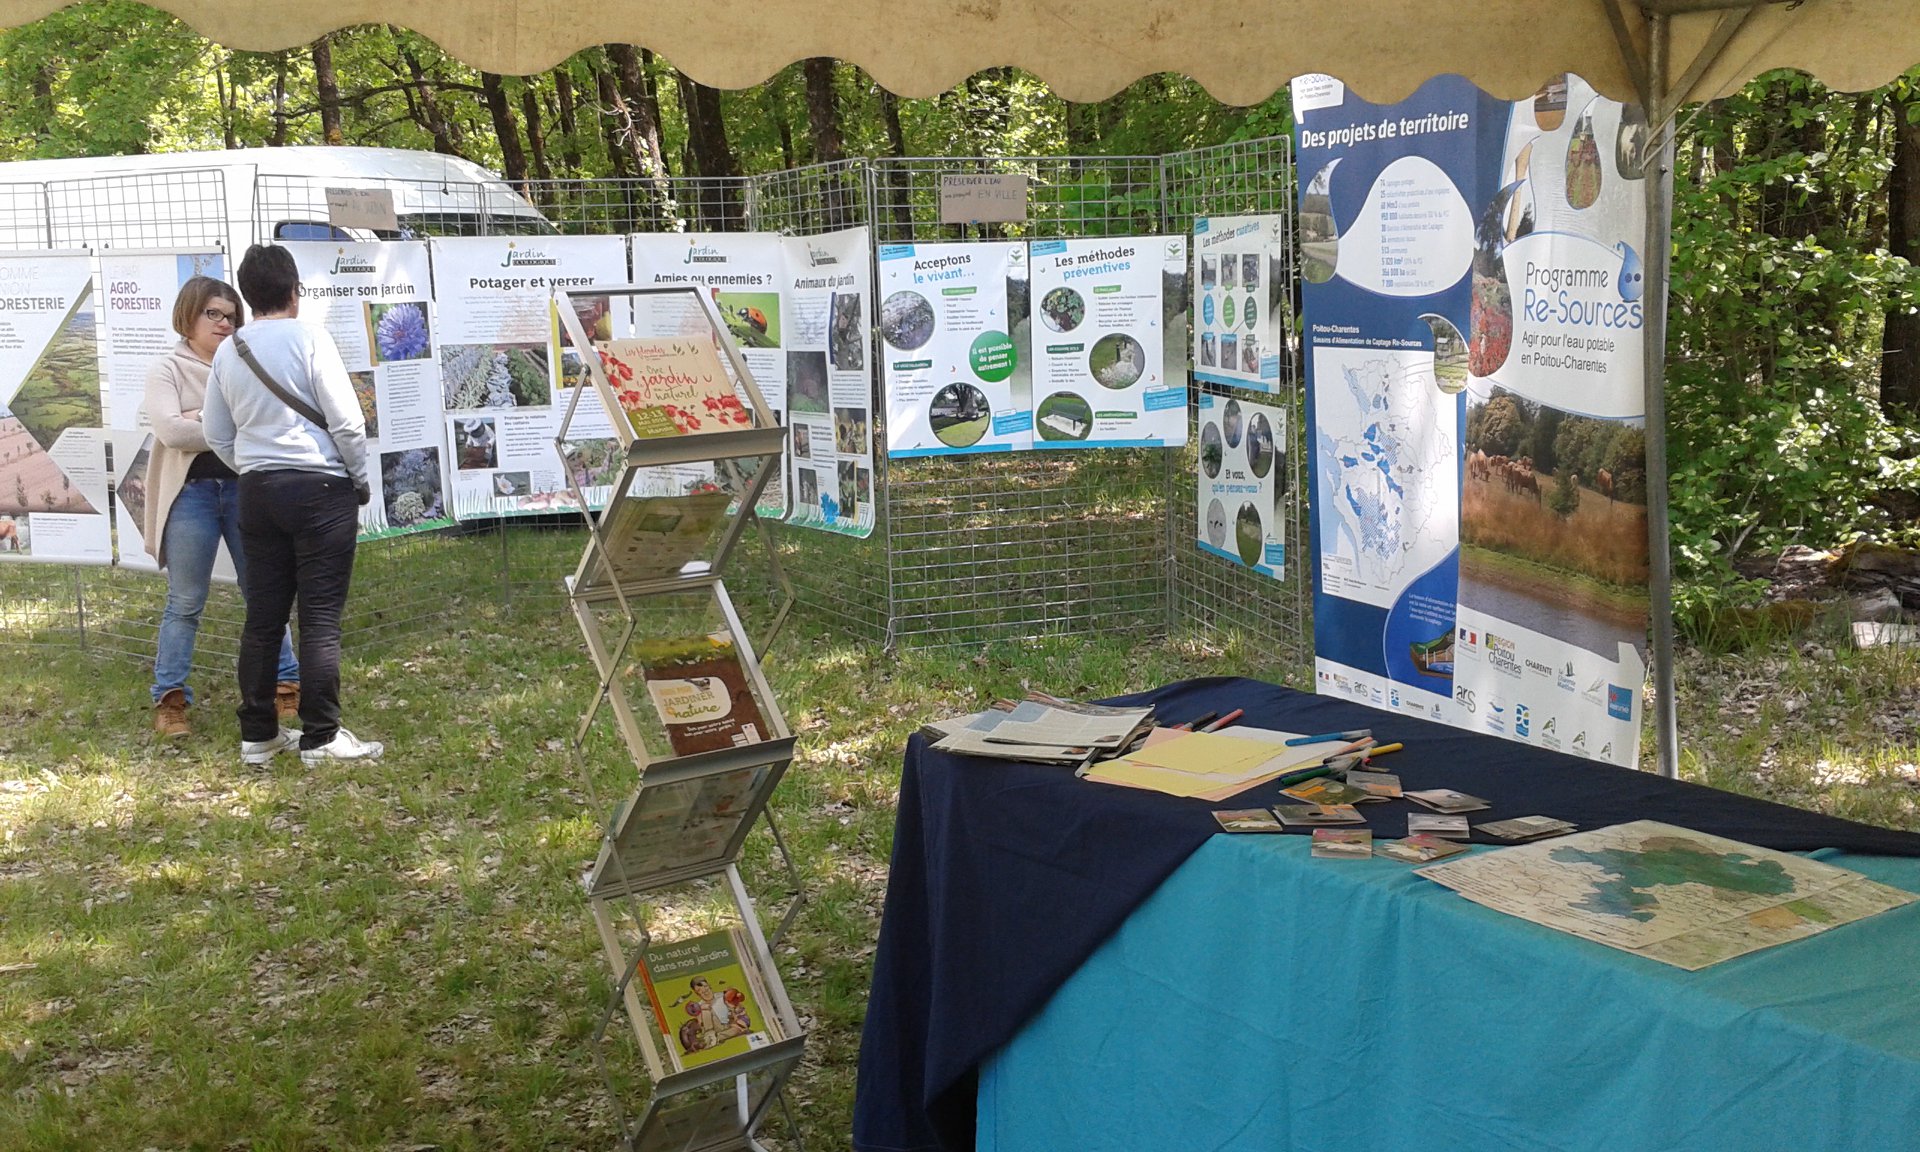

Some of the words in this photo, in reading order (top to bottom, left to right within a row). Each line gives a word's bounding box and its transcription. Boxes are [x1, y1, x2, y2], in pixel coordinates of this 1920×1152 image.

[1302, 130, 1325, 148] Des
[1327, 122, 1376, 149] projets
[1378, 119, 1397, 139] de
[1400, 110, 1469, 136] territoire
[1203, 237, 1211, 247] Les
[501, 247, 546, 267] jardin
[684, 243, 719, 264] jardin
[1054, 257, 1073, 267] Les
[1077, 246, 1135, 264] méthodes
[914, 254, 971, 271] Acceptons
[708, 273, 763, 285] ennemies
[766, 274, 772, 285] ?
[913, 273, 924, 284] le
[1063, 261, 1131, 282] préventives
[1526, 261, 1609, 293] Programme
[110, 282, 141, 294] AGRO-
[470, 277, 526, 290] Potager
[531, 277, 545, 287] et
[794, 277, 826, 290] Animaux
[828, 275, 836, 287] du
[836, 273, 855, 290] jardin
[298, 282, 354, 299] Organiser
[357, 285, 378, 296] son
[381, 283, 415, 298] jardin
[111, 297, 161, 310] FORESTIER
[1524, 288, 1643, 329] Re-Sources
[1313, 324, 1359, 334] Poitou-Charentes
[1522, 331, 1539, 348] Agir
[1541, 335, 1561, 348] pour
[1563, 334, 1584, 349] l'eau
[1587, 337, 1615, 352] potable
[1521, 353, 1531, 365] en
[1534, 352, 1607, 373] Poitou-Charentes
[642, 365, 698, 399] jardin
[655, 385, 699, 401] naturel
[1494, 643, 1515, 662] Poitou
[1489, 651, 1522, 674] Charentes
[1525, 659, 1552, 675] CHARENTE
[663, 690, 715, 707] JARDINER
[674, 703, 721, 718] nature
[649, 953, 663, 962] Du
[666, 944, 701, 959] naturel
[653, 961, 677, 973] dans
[677, 959, 695, 968] nos
[697, 949, 729, 965] jardins
